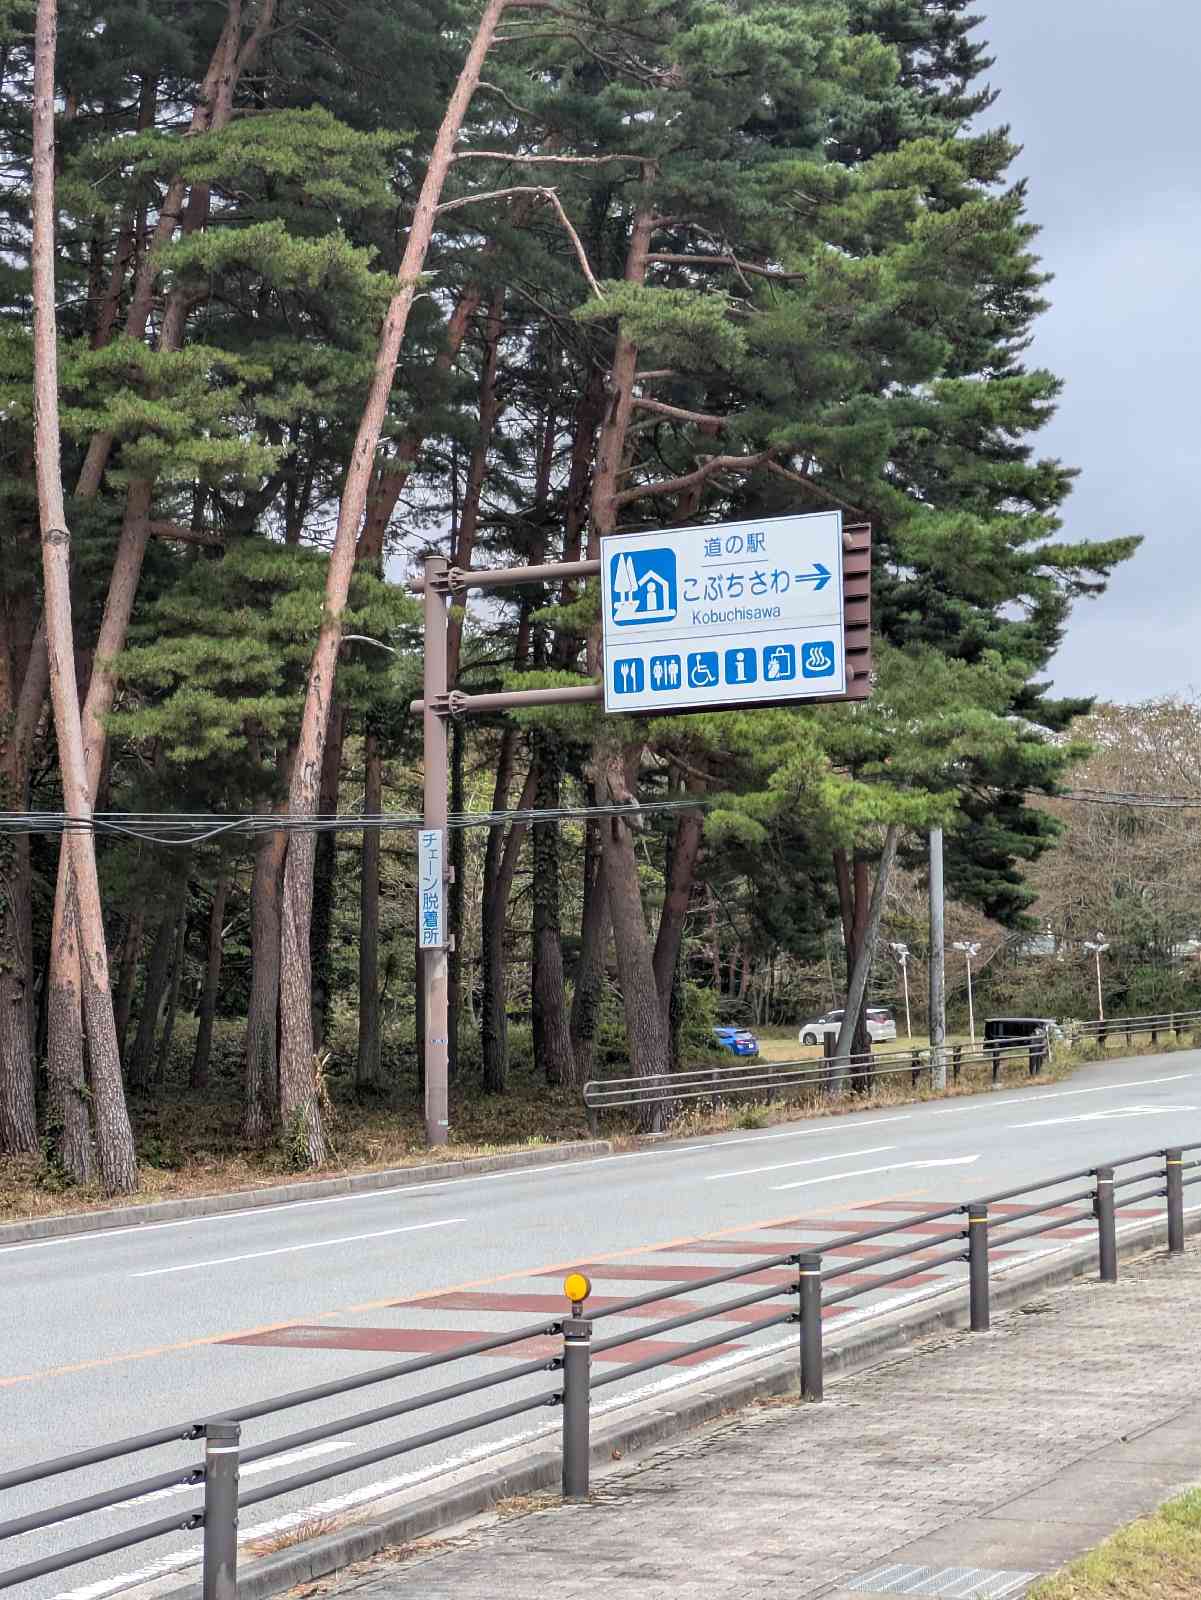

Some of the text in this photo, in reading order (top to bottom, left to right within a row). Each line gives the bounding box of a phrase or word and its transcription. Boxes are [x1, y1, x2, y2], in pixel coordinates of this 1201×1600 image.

[703, 532, 766, 558] 道の駅
[683, 569, 790, 602] こぶちさわ
[692, 606, 781, 625] Kobuchisawa
[422, 832, 440, 945] チェーン脱着所
